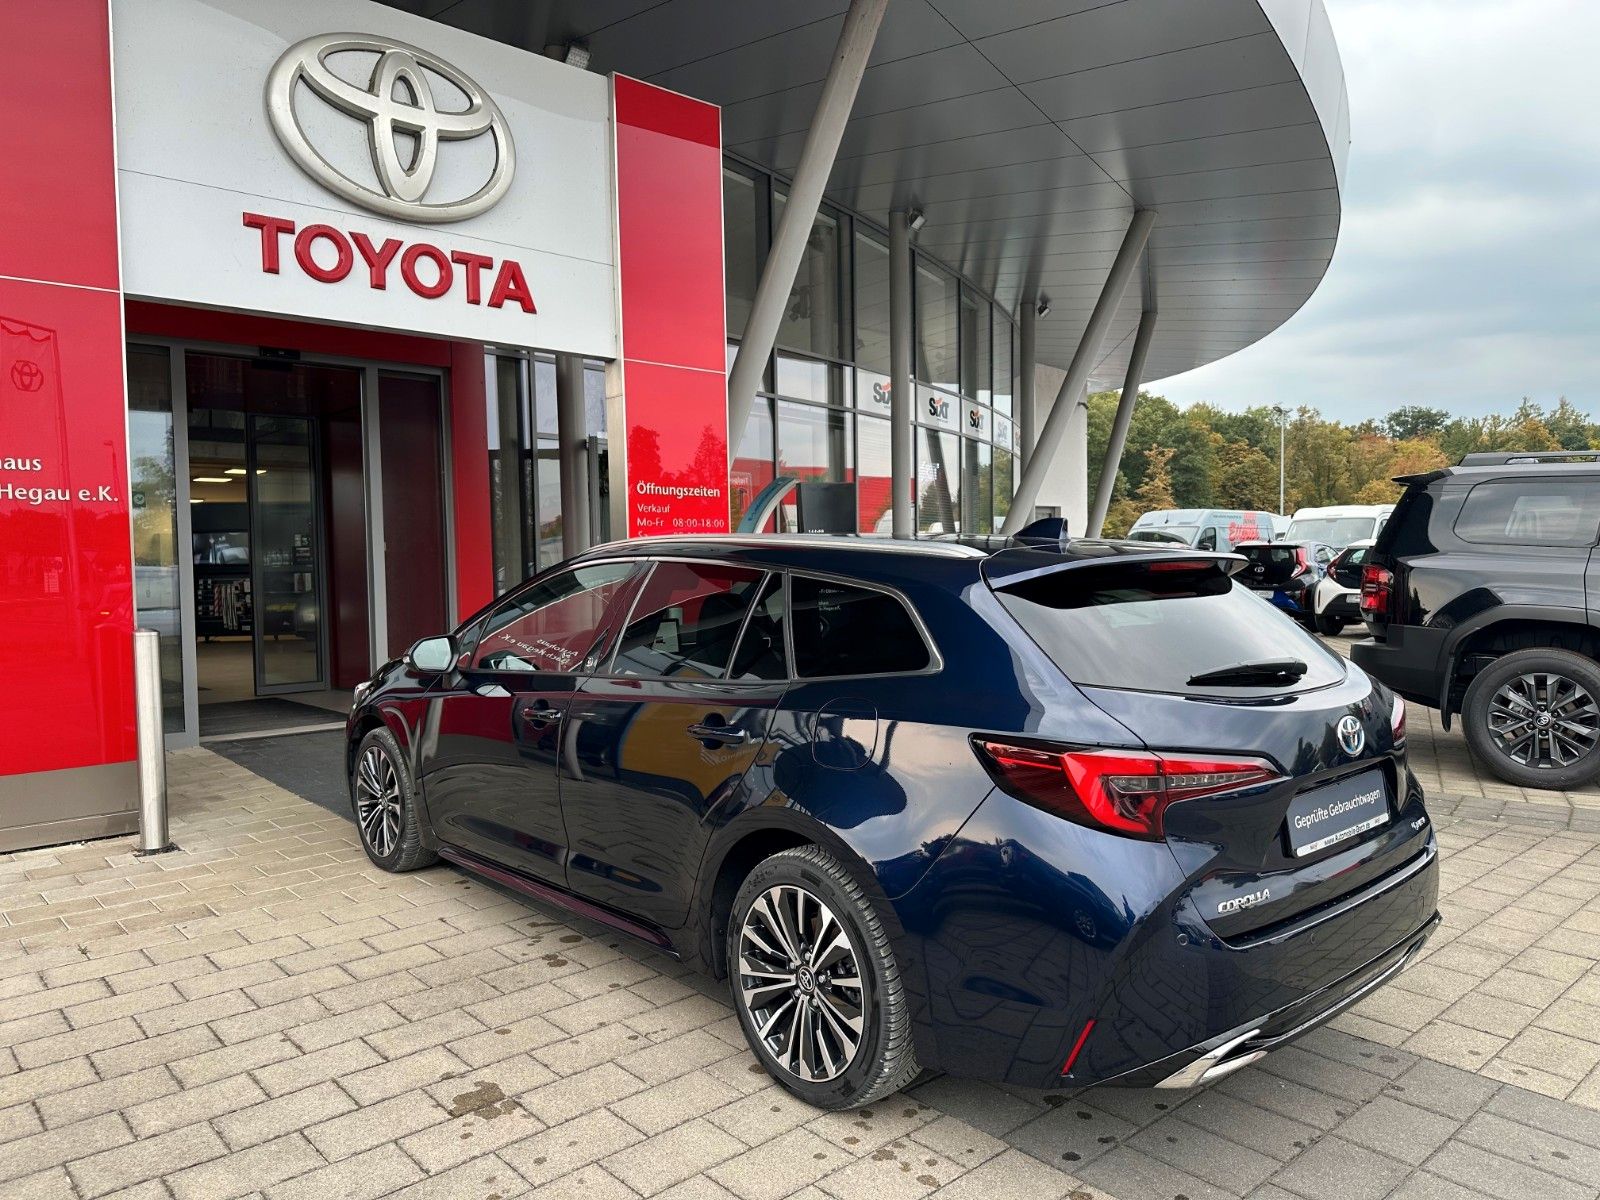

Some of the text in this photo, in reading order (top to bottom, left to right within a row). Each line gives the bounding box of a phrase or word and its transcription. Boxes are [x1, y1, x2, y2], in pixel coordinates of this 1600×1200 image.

[242, 211, 537, 315] TOYOTA
[0, 457, 42, 471] aus
[0, 483, 119, 505] Hegau e.K.
[636, 481, 720, 499] Öffnungszeiten
[637, 503, 671, 513] Verkauf
[637, 517, 725, 528] Mo-Fr 08:00-18:00
[1294, 789, 1381, 829] Geprüfte Gebrauchtwagen
[1217, 889, 1270, 913] COROLLA
